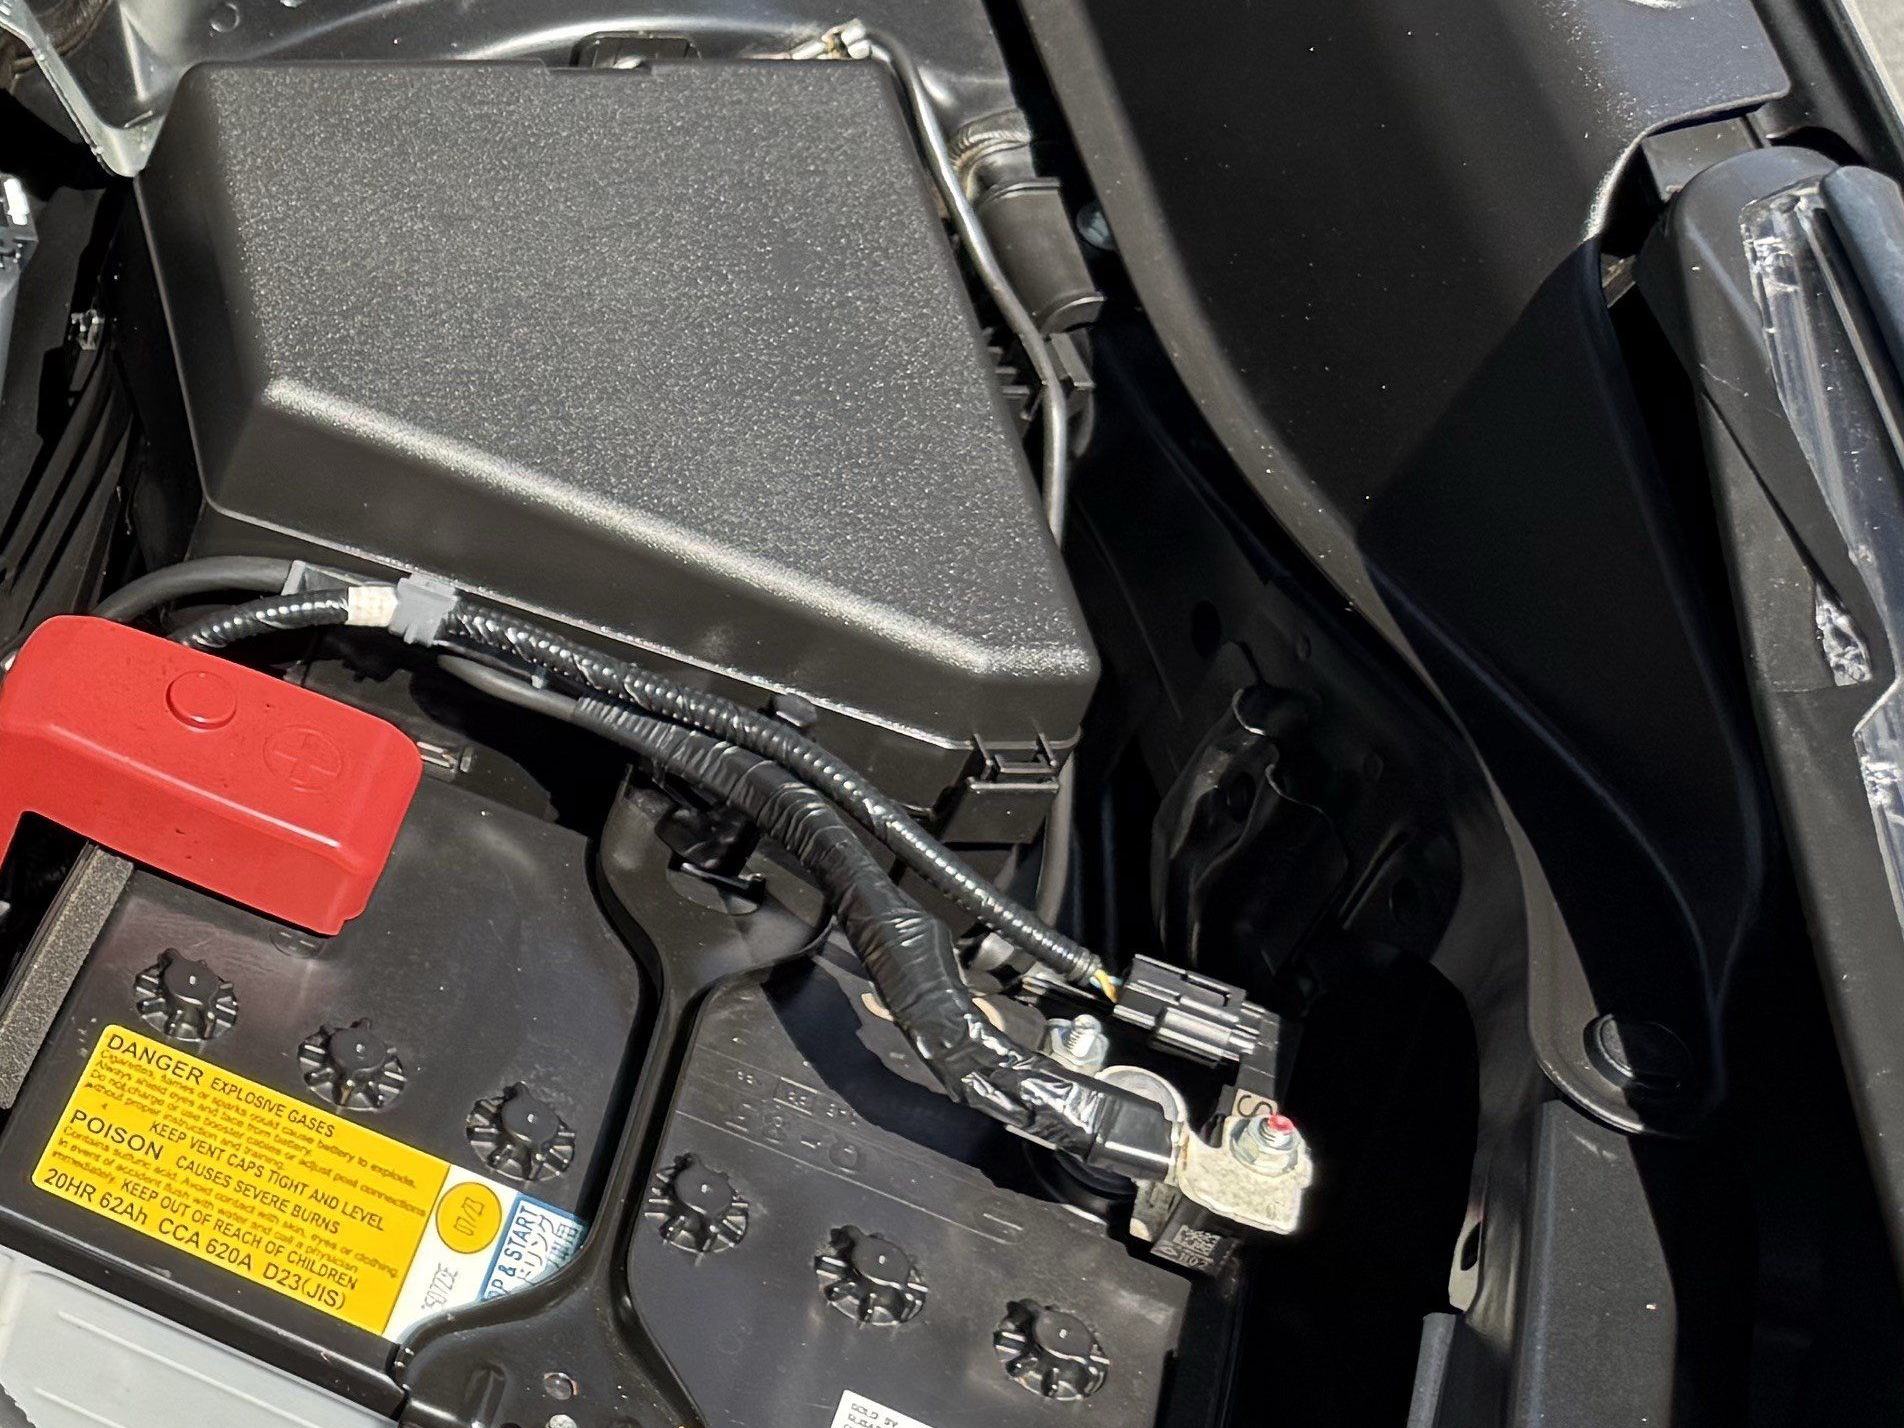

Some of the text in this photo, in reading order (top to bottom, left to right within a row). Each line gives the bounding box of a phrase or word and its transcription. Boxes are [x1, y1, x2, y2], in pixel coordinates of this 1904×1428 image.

[106, 1033, 336, 1138] DANGER EXPLOSIVE GASES
[69, 1108, 341, 1235] POISON CAUSES SEVERE BURNS
[148, 1120, 388, 1231] KEEP VENT CAPS TIGHT AND LEVEL
[42, 1167, 348, 1311] 20HR 62Ah CCA 620A D23(JIS)
[119, 1178, 359, 1290] KEEP OUT OF REACH OF CHILDREN
[504, 1205, 533, 1261] START
